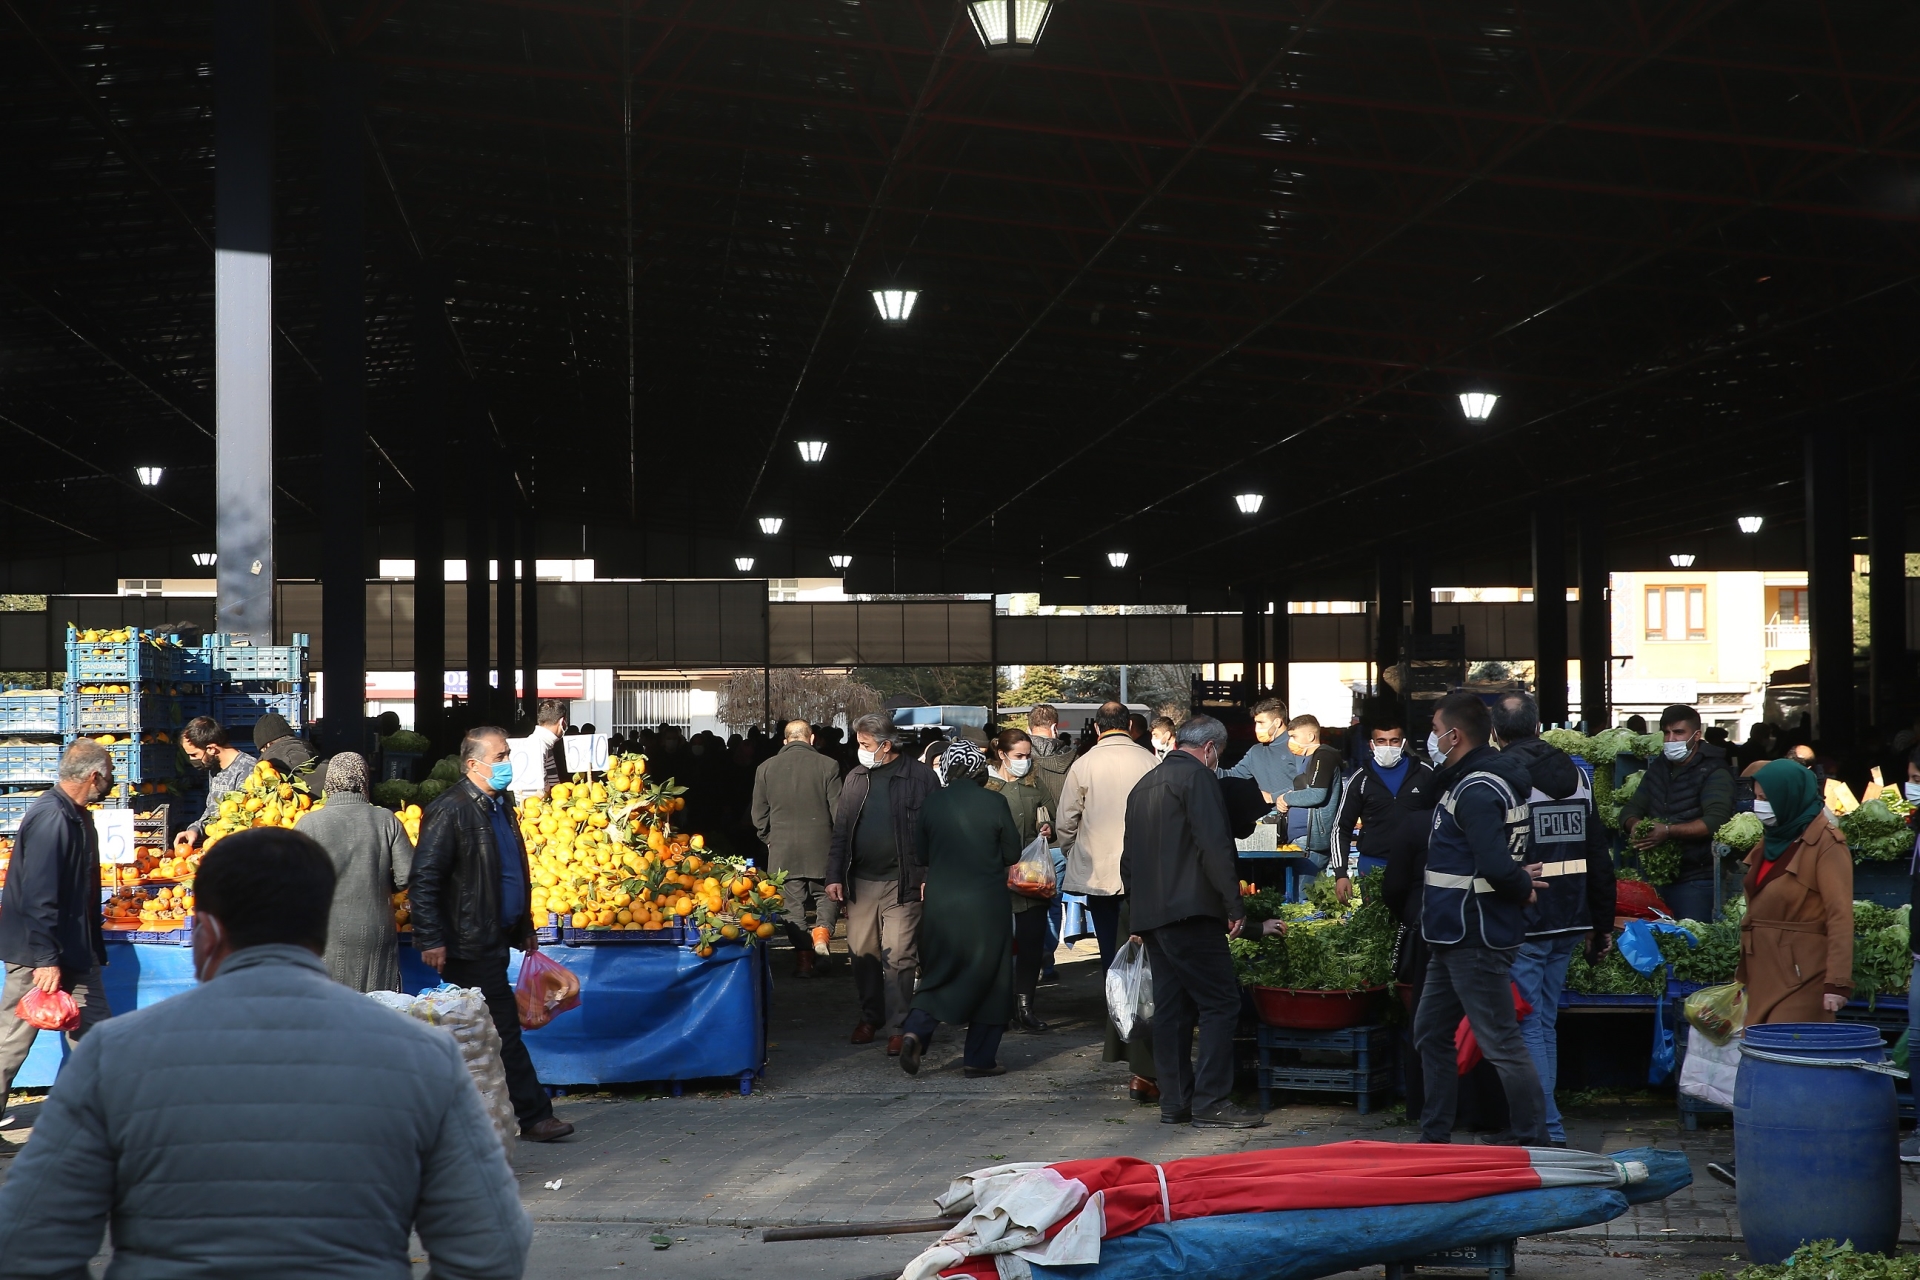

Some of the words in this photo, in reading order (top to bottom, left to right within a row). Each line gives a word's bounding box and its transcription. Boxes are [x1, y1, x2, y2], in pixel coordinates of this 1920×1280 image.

[512, 751, 537, 785] 2
[567, 738, 580, 770] 5
[105, 824, 126, 861] 5
